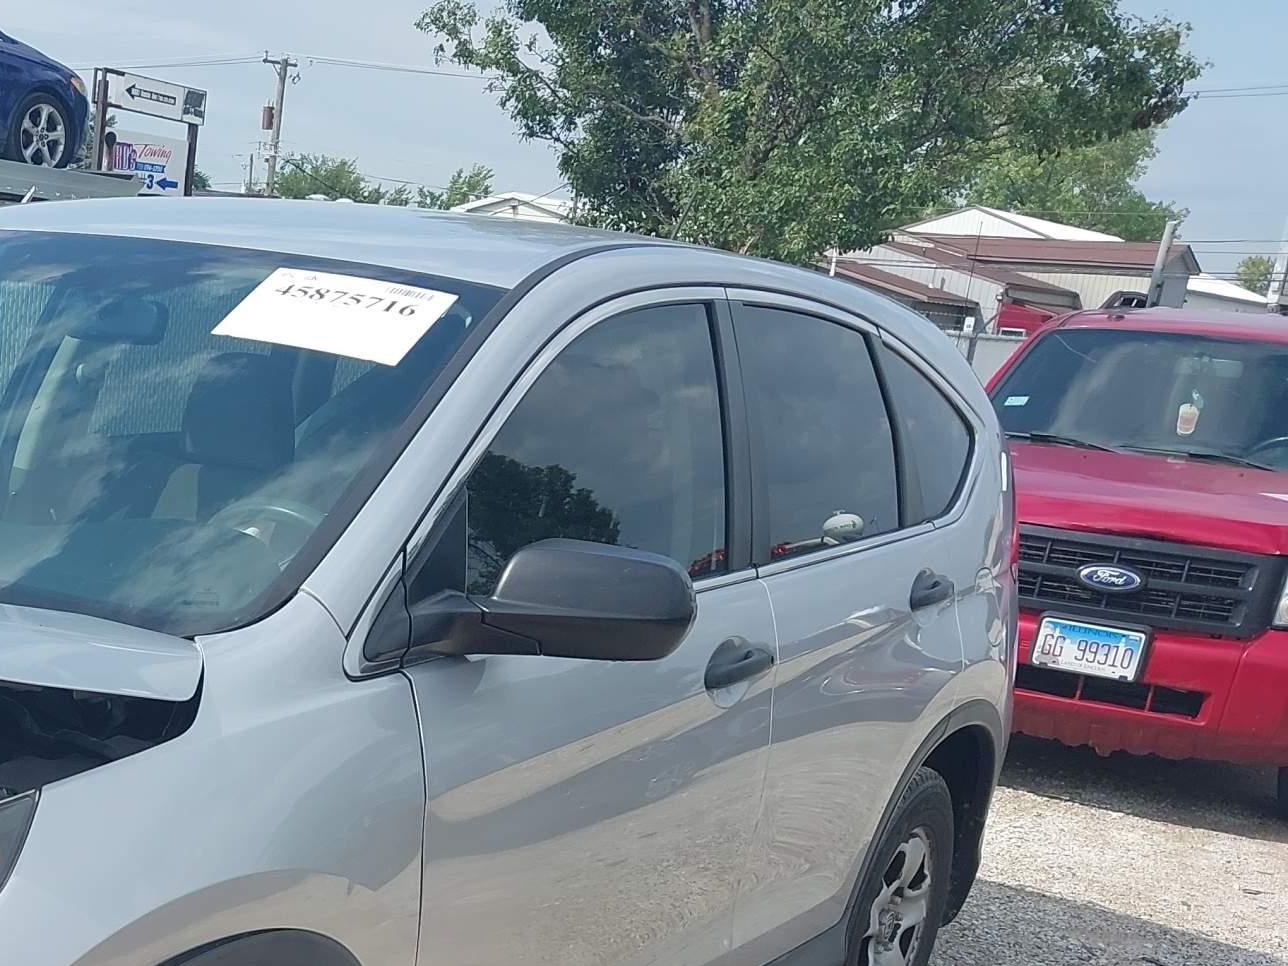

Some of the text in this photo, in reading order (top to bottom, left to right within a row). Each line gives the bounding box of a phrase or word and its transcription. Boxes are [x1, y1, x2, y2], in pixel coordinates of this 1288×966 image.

[134, 144, 172, 165] Towing
[275, 283, 419, 318] 45875716
[1093, 569, 1128, 585] Ford
[1040, 633, 1066, 657] GG
[1074, 639, 1134, 670] 99310
